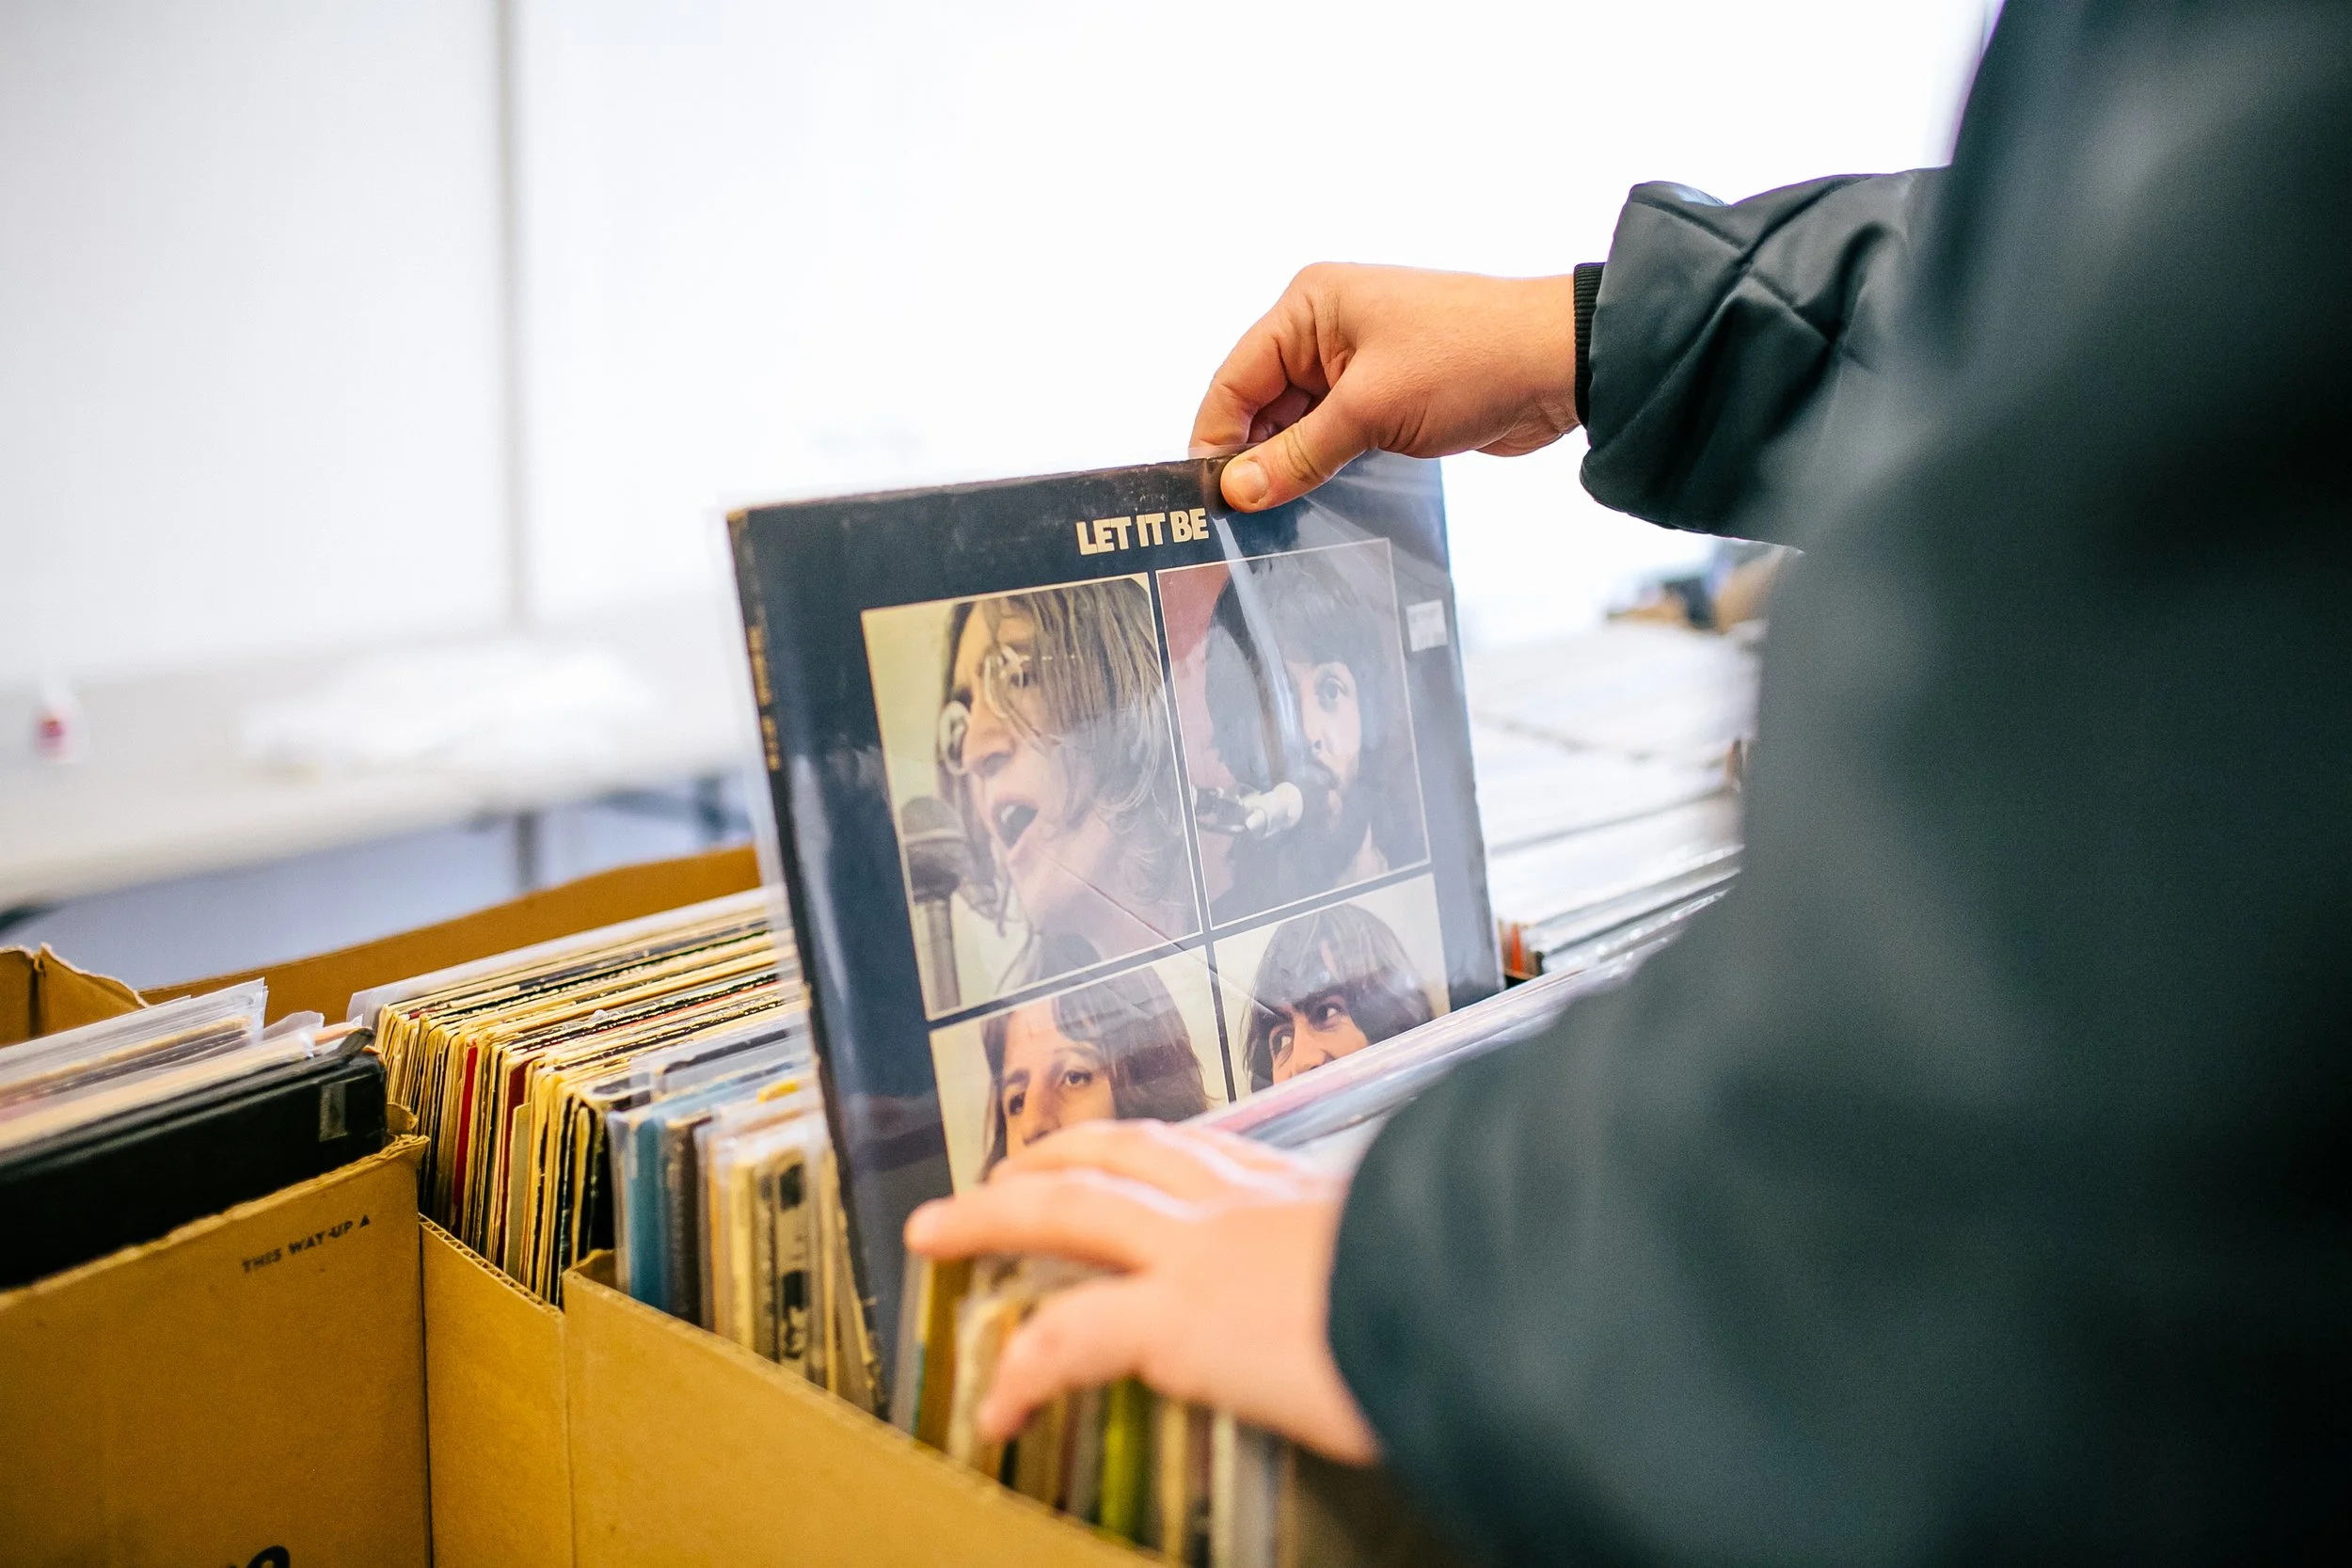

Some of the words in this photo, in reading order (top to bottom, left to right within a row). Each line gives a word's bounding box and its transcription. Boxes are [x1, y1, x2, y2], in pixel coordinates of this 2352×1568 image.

[1075, 516, 1132, 556] LET
[1136, 513, 1167, 547] IT
[1169, 507, 1210, 544] BE
[242, 1247, 282, 1274] THIS
[288, 1231, 326, 1255] WAY
